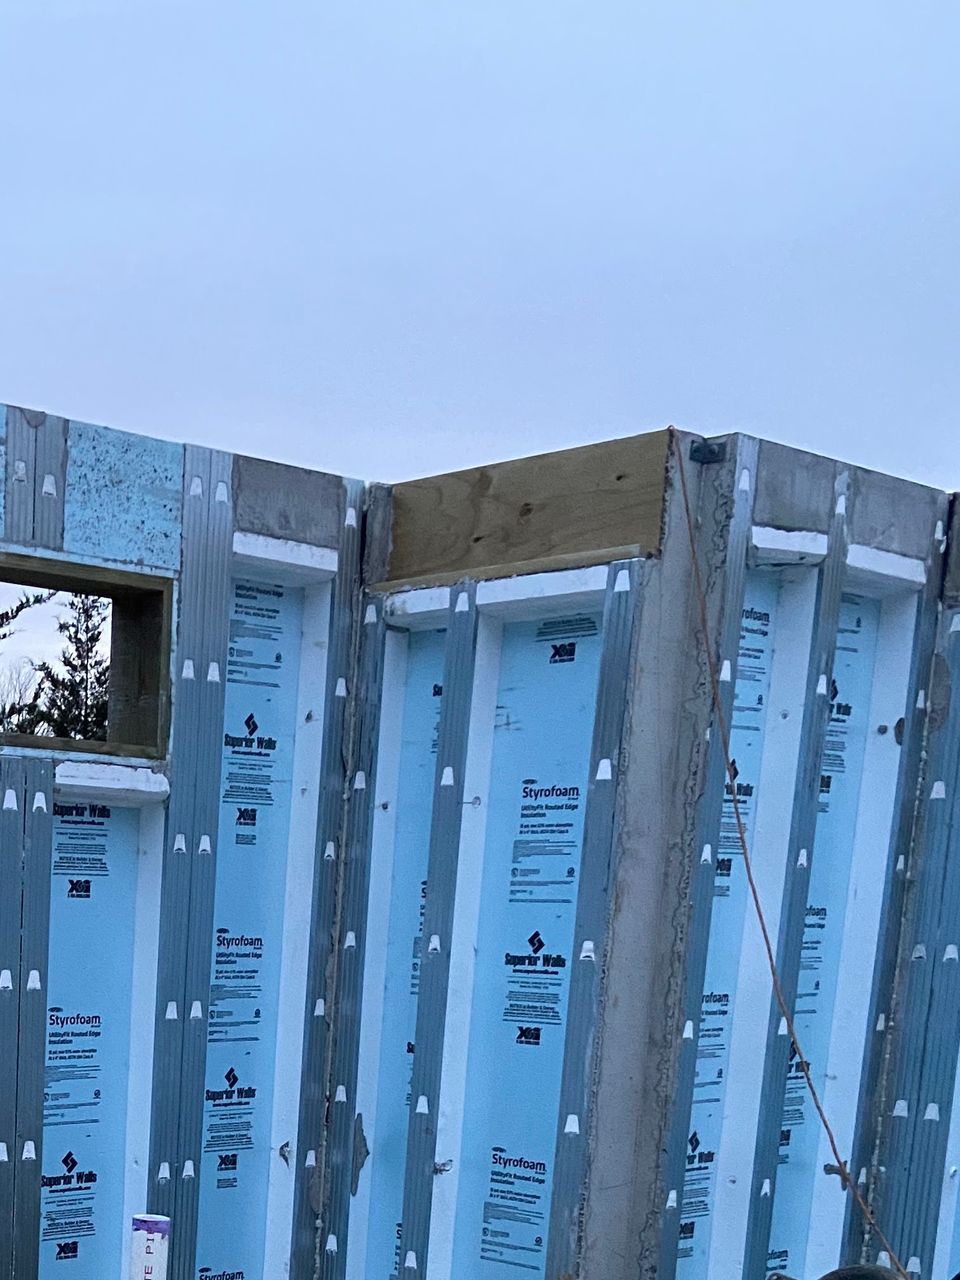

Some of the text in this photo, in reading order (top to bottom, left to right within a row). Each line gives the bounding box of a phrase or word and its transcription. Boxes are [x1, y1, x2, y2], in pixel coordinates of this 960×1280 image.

[741, 607, 770, 624] rofoam
[522, 785, 579, 800] Styrofoam
[565, 803, 579, 811] Edge
[216, 935, 262, 949] Styrofoam
[505, 953, 566, 968] Superior Walls
[701, 992, 729, 1004] rofoam
[49, 1013, 101, 1028] Styrofoam
[492, 1153, 546, 1171] Styrofoam
[41, 1171, 97, 1188] Superior Walls
